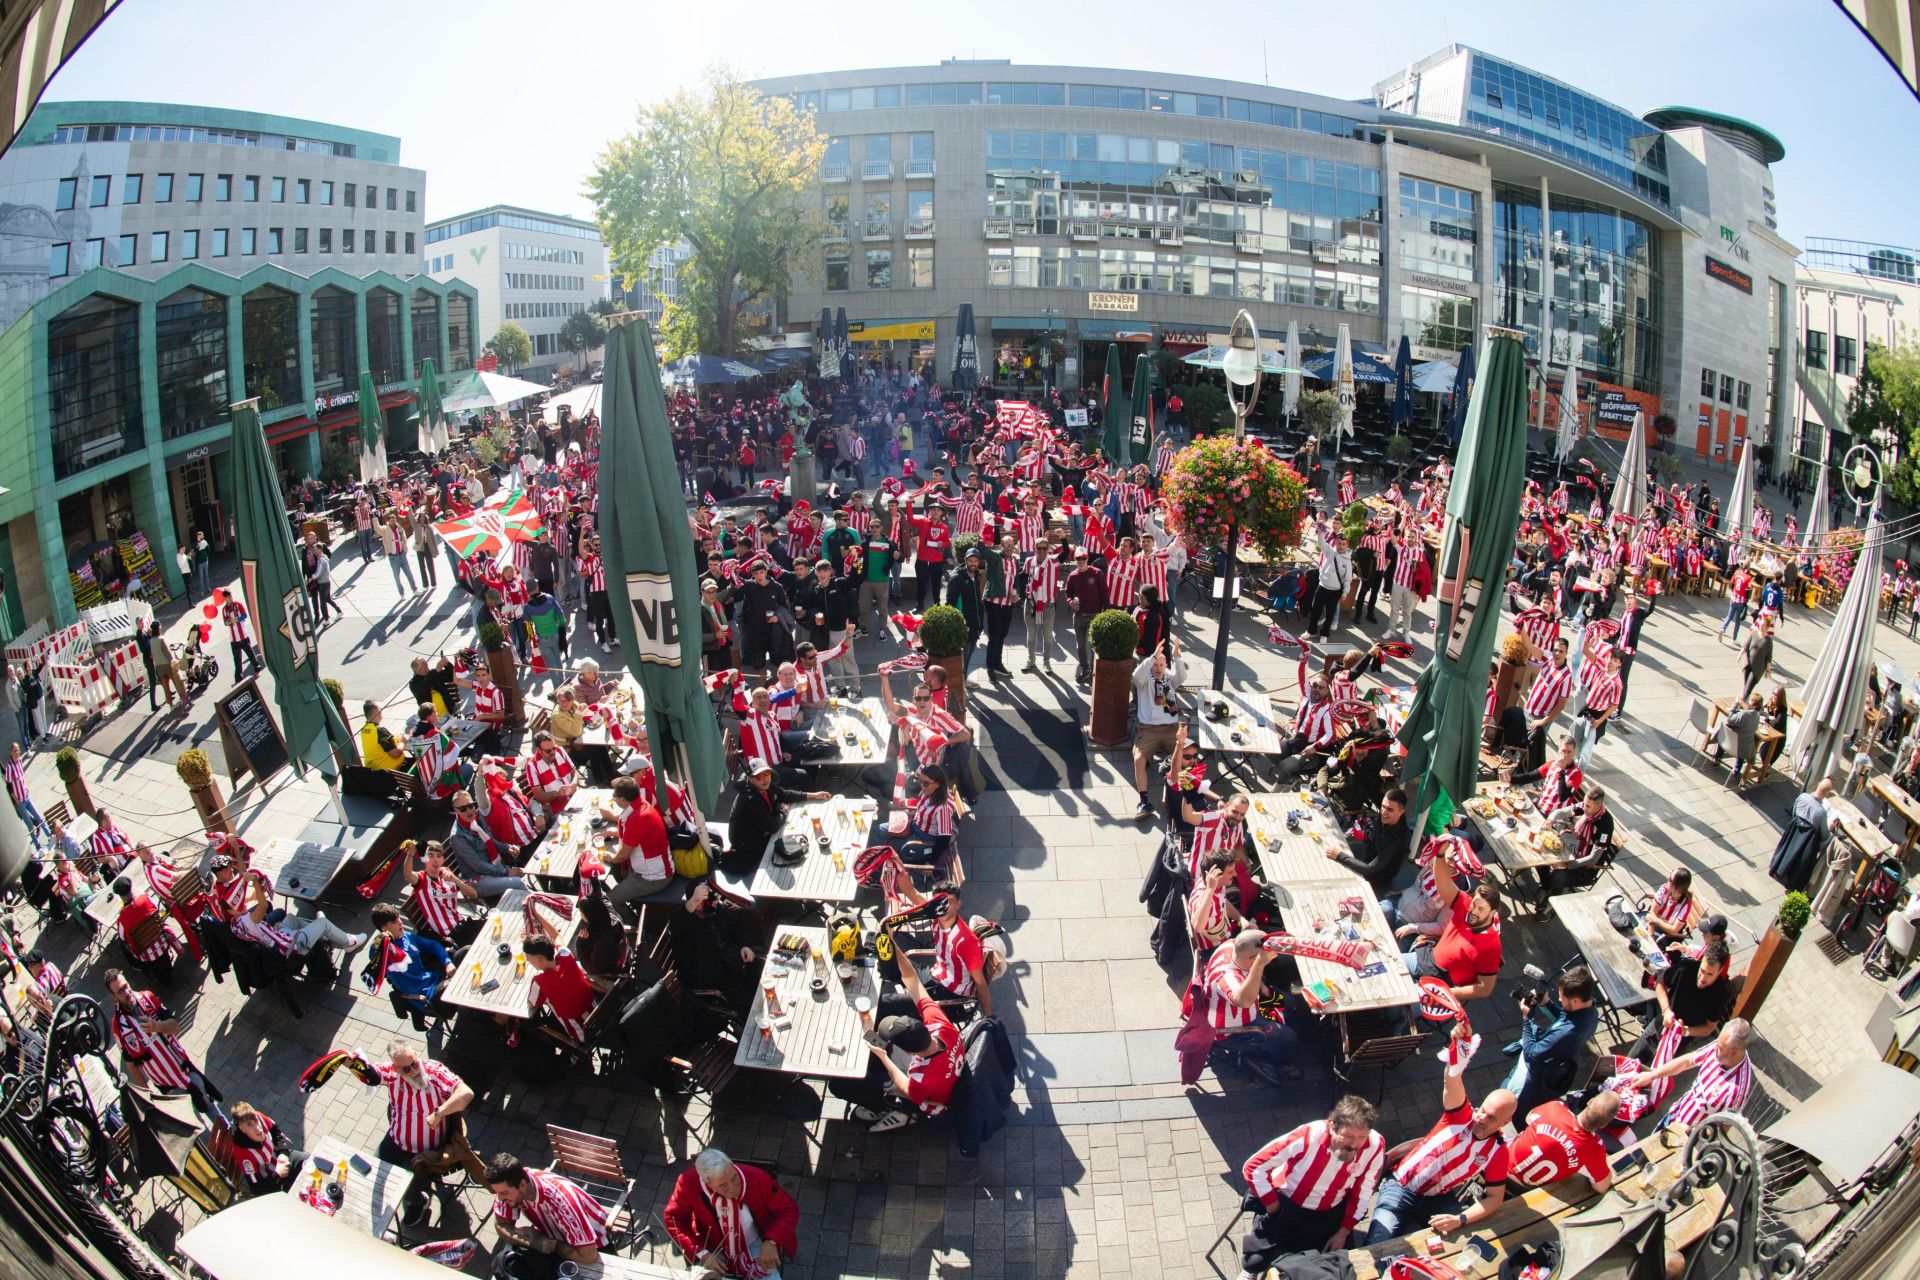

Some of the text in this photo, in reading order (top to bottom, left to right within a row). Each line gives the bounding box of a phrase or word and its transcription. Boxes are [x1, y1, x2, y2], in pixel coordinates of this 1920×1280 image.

[1710, 262, 1750, 288] SportScheck
[1091, 294, 1135, 303] KRONEN
[1599, 411, 1623, 420] RABATT
[187, 446, 209, 460] MACAO
[840, 939, 856, 950] BVB
[1536, 1123, 1579, 1169] WILLIAMS JR
[1513, 1145, 1558, 1187] 10
